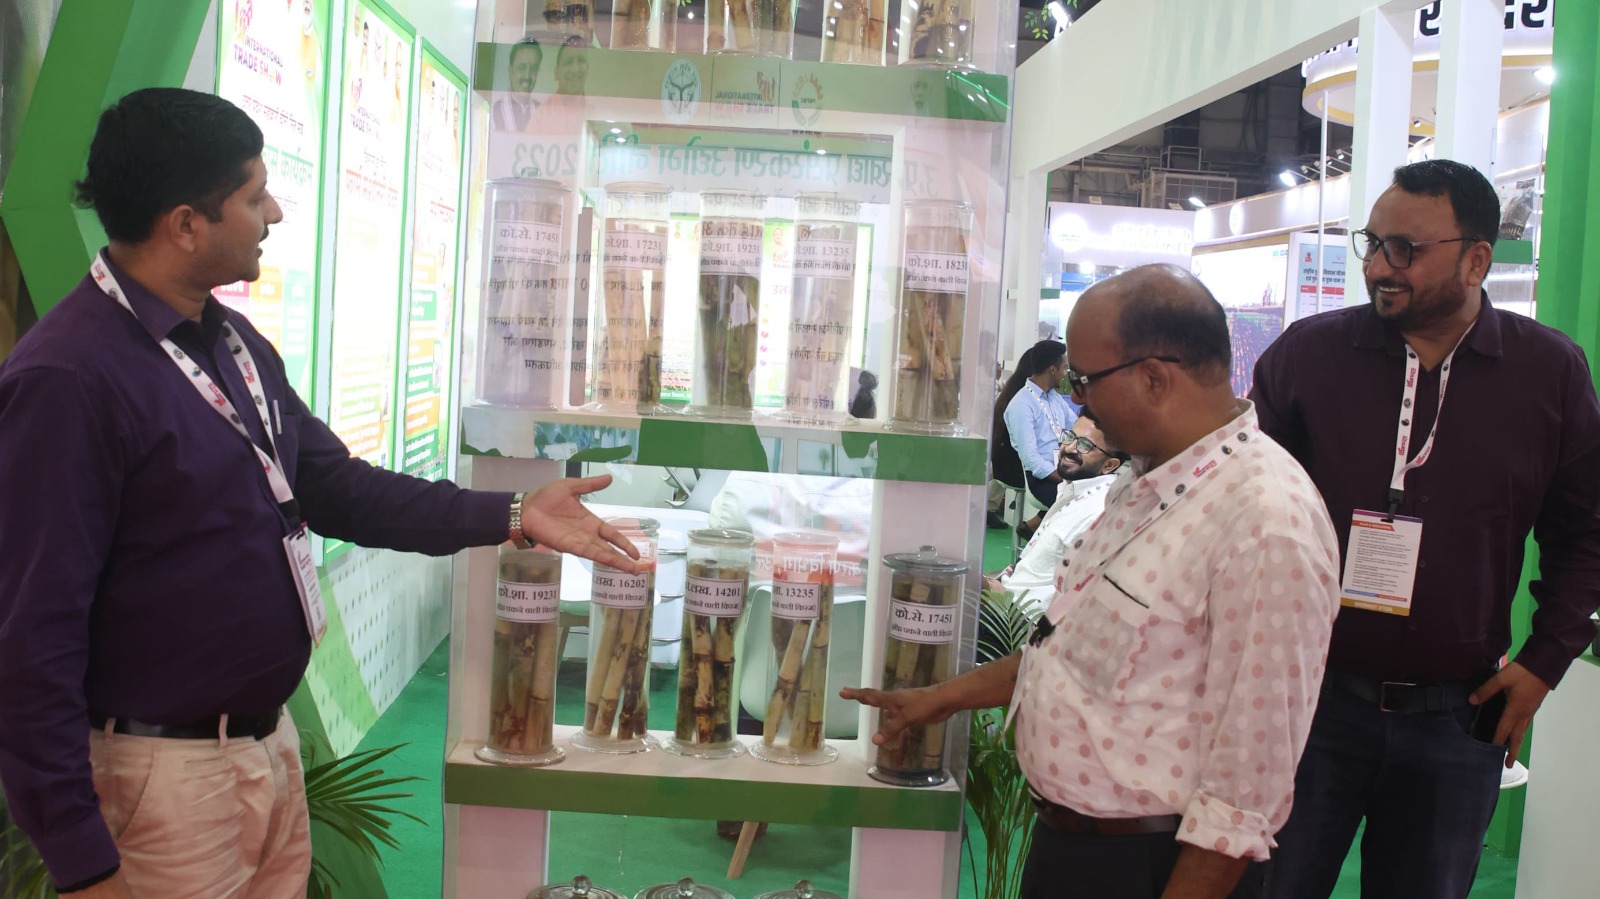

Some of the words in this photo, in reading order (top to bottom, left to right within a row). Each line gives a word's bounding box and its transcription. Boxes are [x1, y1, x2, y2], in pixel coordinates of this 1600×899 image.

[233, 44, 258, 73] TRADE
[244, 35, 284, 68] INTERNATIONAL
[619, 579, 646, 588] 16202
[498, 585, 528, 600] को.शा.
[532, 590, 557, 601] 19231
[715, 587, 741, 597] 14201
[785, 587, 814, 598] 13235
[895, 606, 925, 622] को.से.
[928, 613, 953, 624] 17451
